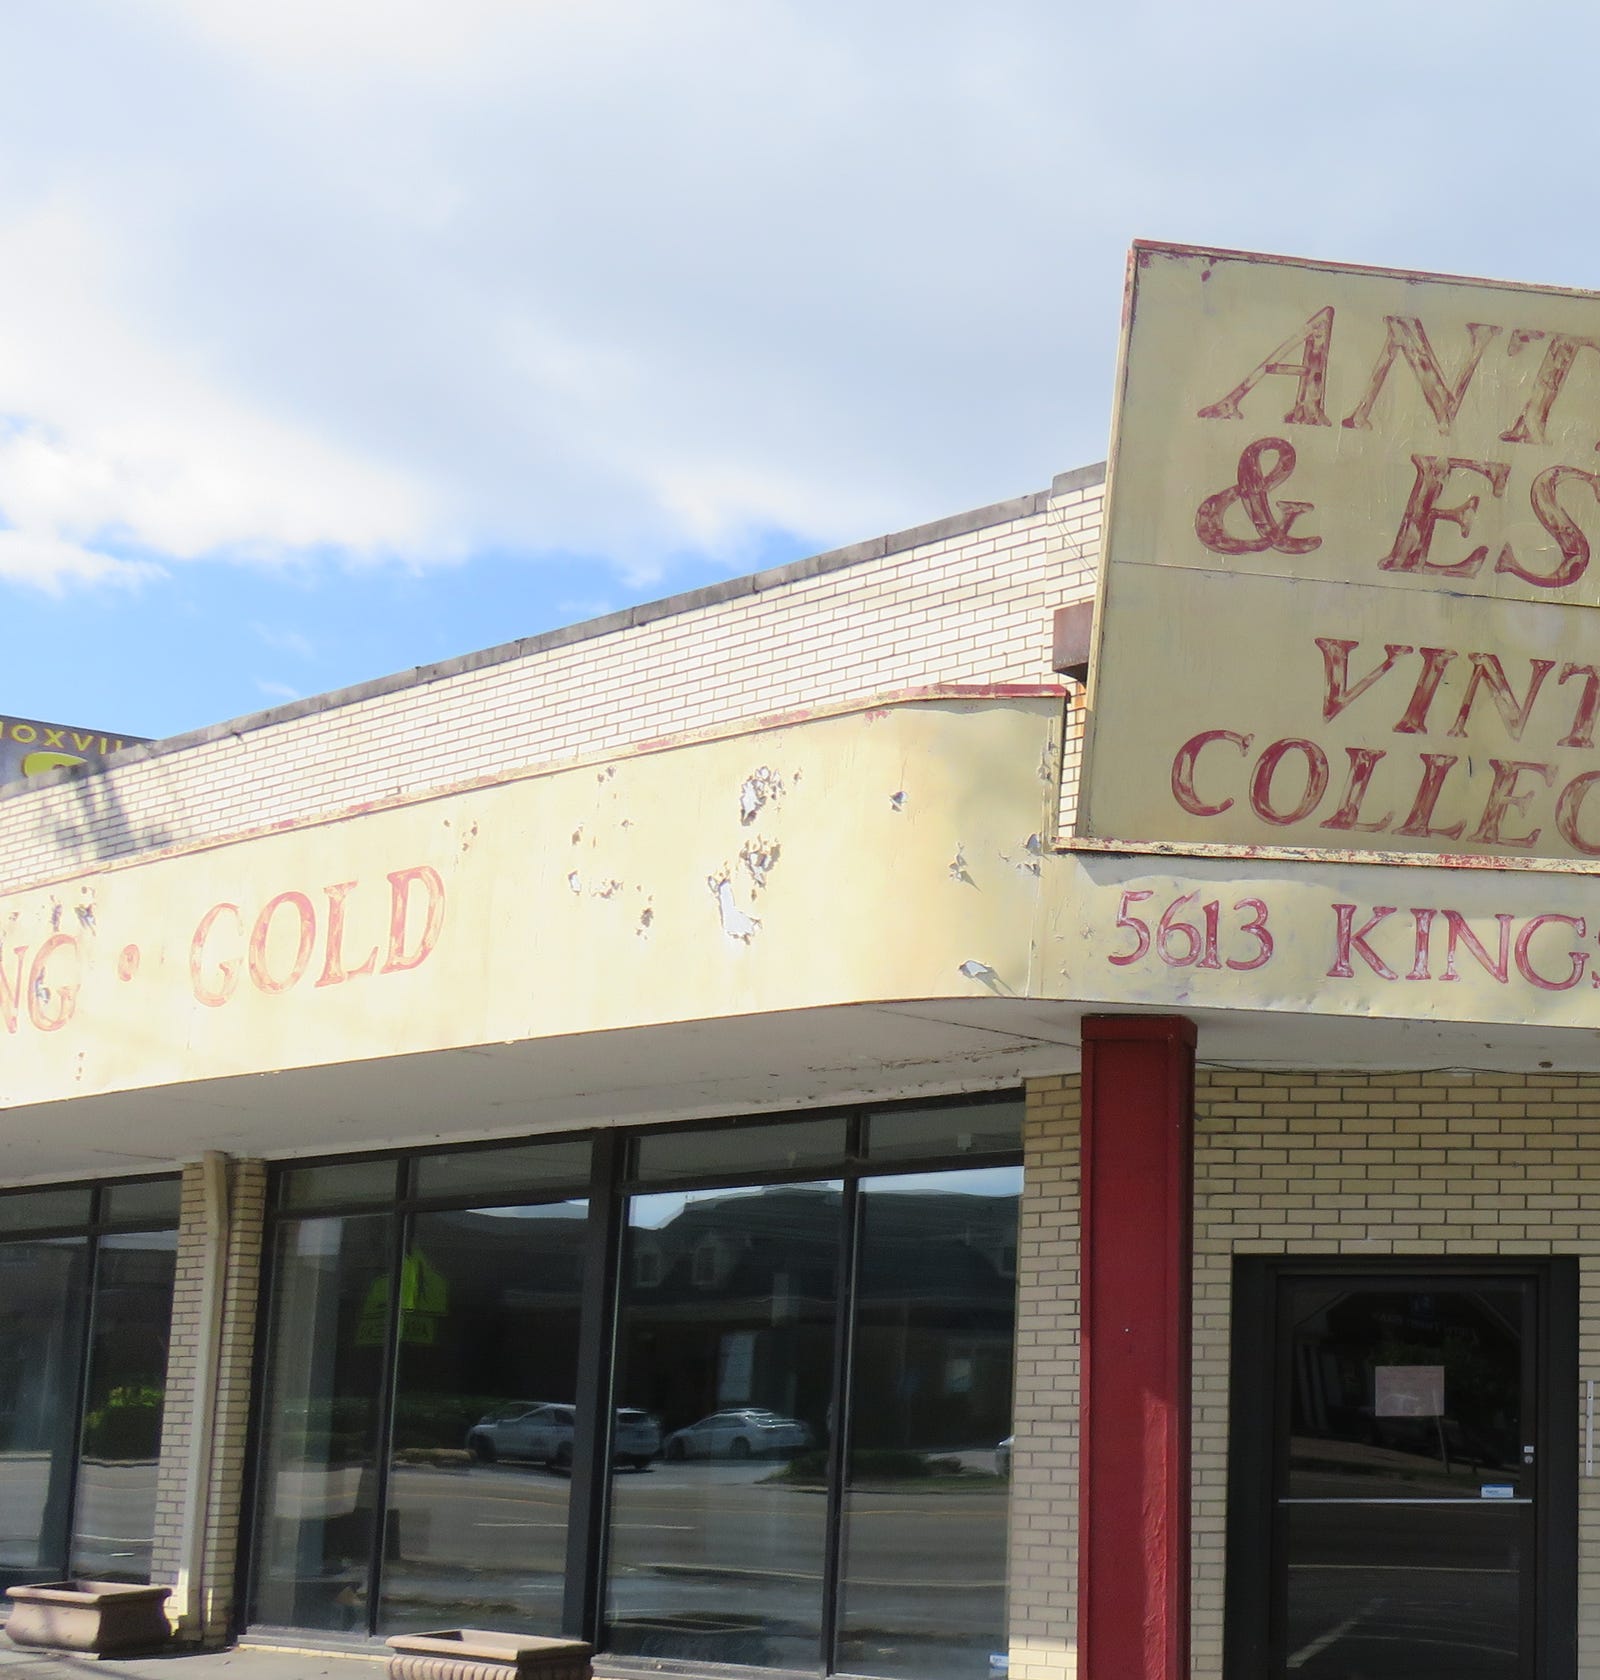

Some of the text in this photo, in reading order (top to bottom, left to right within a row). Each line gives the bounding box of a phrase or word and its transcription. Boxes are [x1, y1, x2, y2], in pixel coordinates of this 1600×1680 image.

[1195, 437, 1322, 555] &
[190, 866, 445, 1007] GOLD
[1107, 889, 1275, 971] 5613
